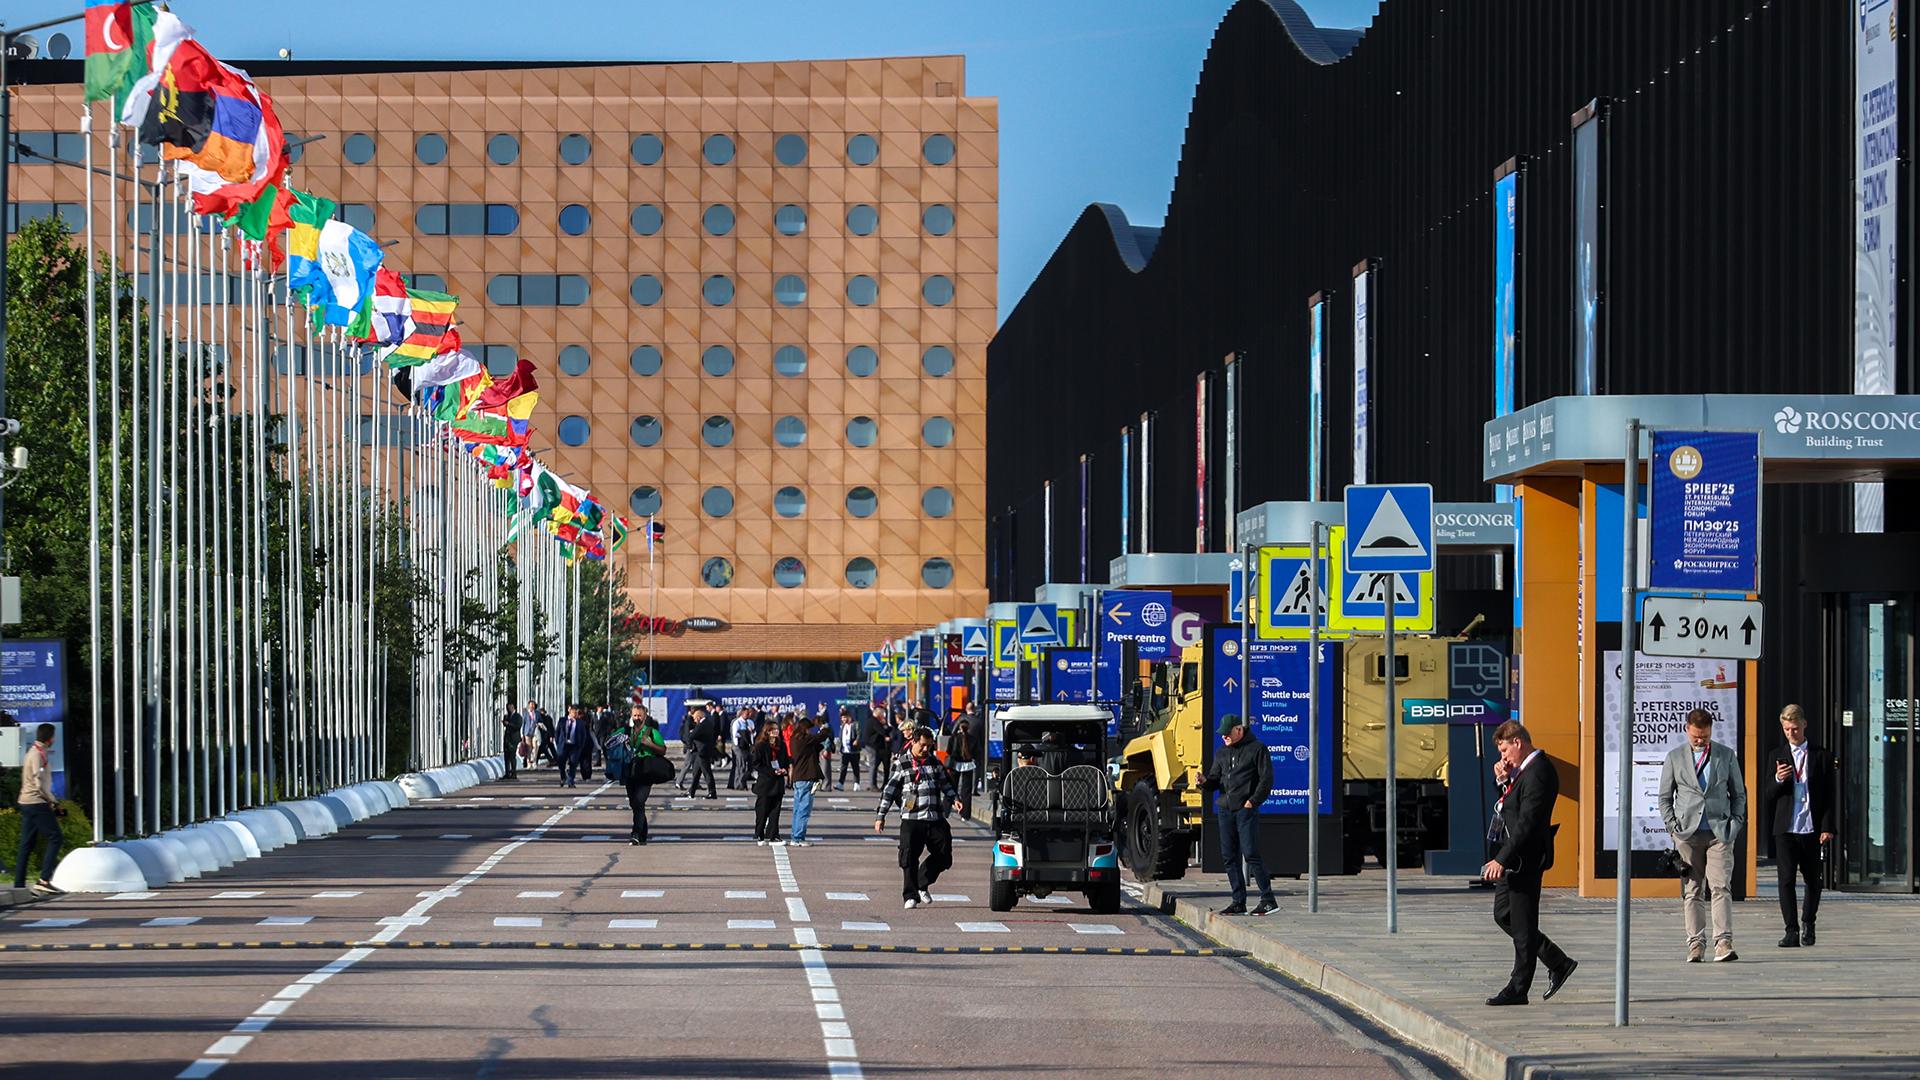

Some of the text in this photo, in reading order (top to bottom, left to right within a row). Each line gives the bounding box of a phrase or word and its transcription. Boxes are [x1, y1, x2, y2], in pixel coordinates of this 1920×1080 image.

[1806, 435, 1884, 450] Building Trust
[1685, 483, 1735, 495] SPIEF'25
[1456, 529, 1476, 537] Trust
[1683, 561, 1739, 569] РОСКОНГРЕСС
[692, 618, 717, 627] Hilton
[1171, 612, 1202, 648] G
[1135, 633, 1166, 643] centre
[1261, 690, 1311, 699] Shuttle buse
[721, 695, 793, 706] ПЕТЕРБУРГСКИЙ
[1641, 701, 1719, 711] PETERSBURG
[1261, 714, 1298, 723] VinoGrad
[1262, 724, 1293, 732] ВиноГрад
[1270, 788, 1310, 796] restaurant
[1288, 797, 1305, 805] СМИ
